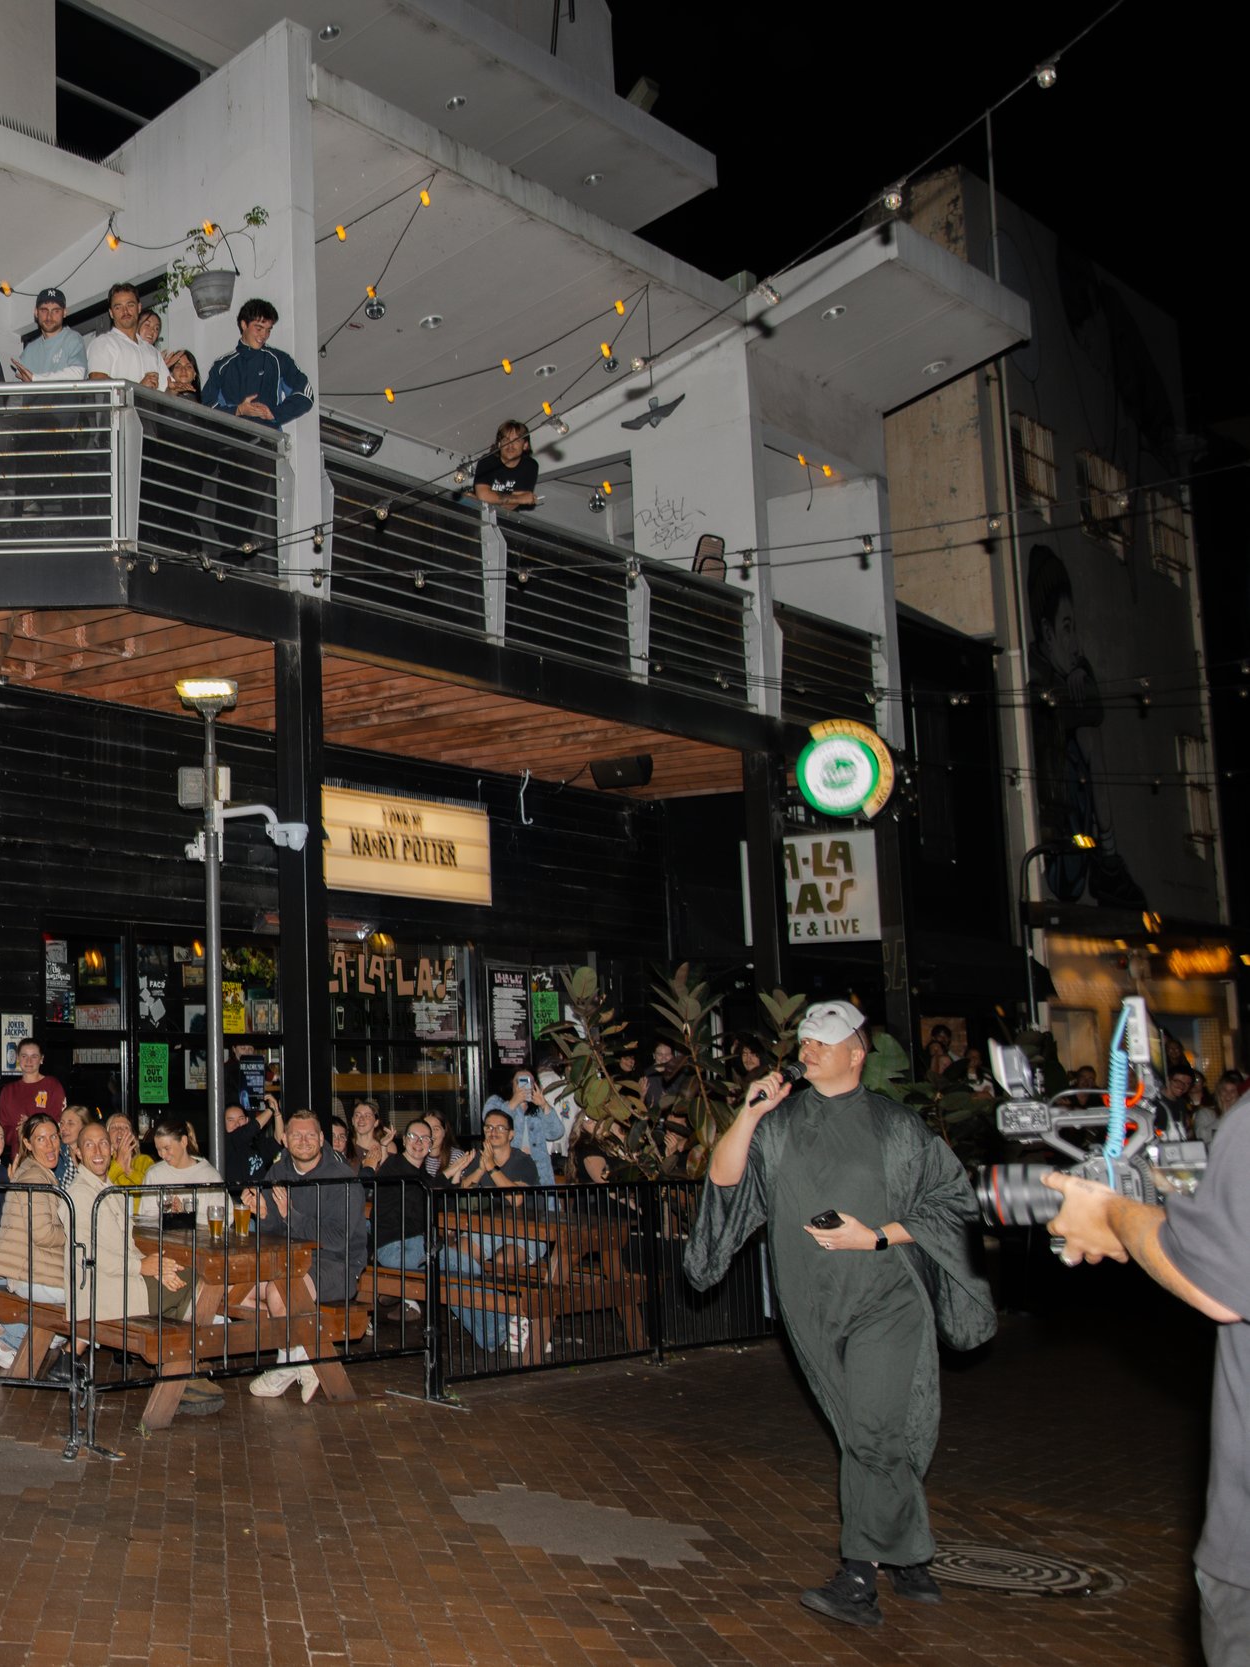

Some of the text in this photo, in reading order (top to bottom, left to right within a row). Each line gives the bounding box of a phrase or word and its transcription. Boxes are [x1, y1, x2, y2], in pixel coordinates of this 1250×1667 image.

[349, 827, 458, 868] HARRY POTTER
[806, 921, 819, 937] &
[824, 918, 860, 936] LIVE
[8, 1021, 25, 1029] JOKER
[4, 1028, 29, 1037] JACKPOT
[146, 1068, 161, 1076] OUT
[143, 1075, 163, 1083] LOUD
